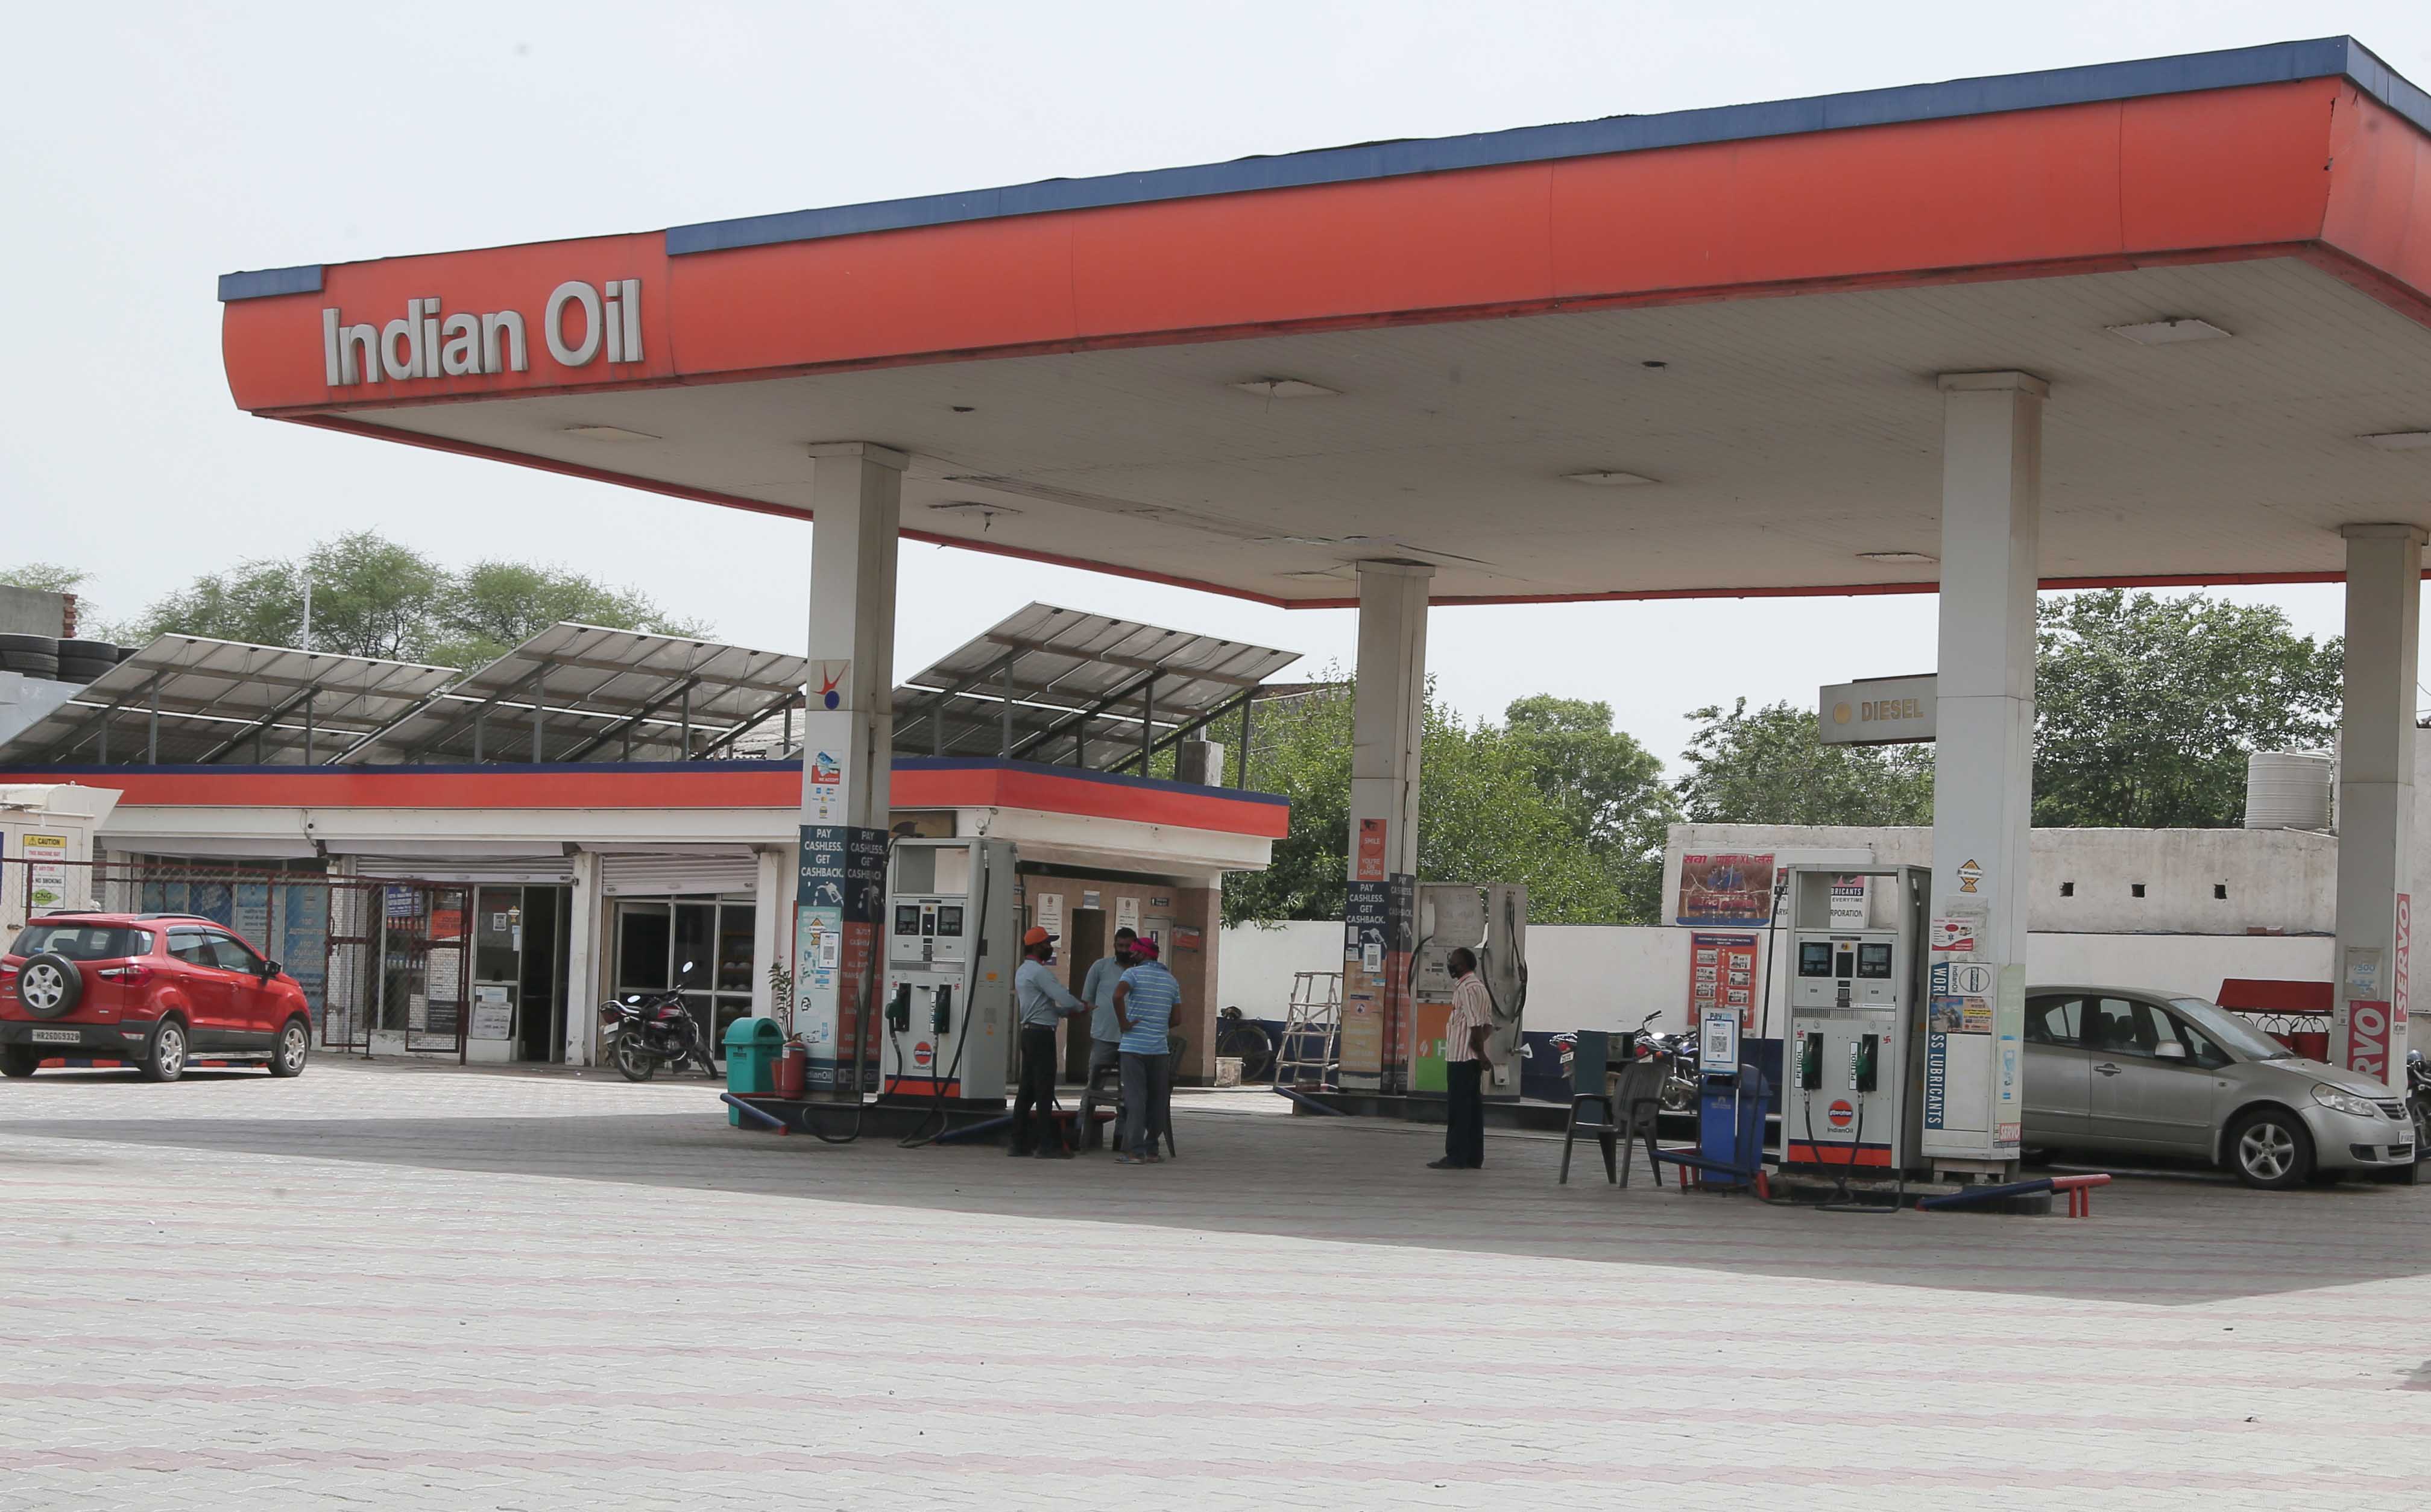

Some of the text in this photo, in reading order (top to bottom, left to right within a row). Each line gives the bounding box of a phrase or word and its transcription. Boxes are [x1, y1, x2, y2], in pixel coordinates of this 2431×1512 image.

[323, 279, 644, 386] Indian Oil
[1861, 698, 1925, 722] DIESEL
[816, 828, 832, 839] PAY
[861, 831, 875, 841] PAY
[804, 841, 843, 852] CASHLESS.
[815, 854, 831, 865] GET
[801, 866, 844, 878] CASHBACK.
[1360, 884, 1374, 892] PAY
[1831, 887, 1862, 896] BRICANTS
[1349, 894, 1385, 902] CASHLESS.
[1360, 905, 1373, 913] GET
[1346, 915, 1386, 924] CASHBACK.
[2397, 900, 2409, 1015] SERVO
[2353, 1007, 2385, 1081] RVO
[807, 1071, 831, 1080] dianOil
[1928, 1054, 1944, 1124] LUBRICANTS
[1999, 1123, 2021, 1141] SERVO
